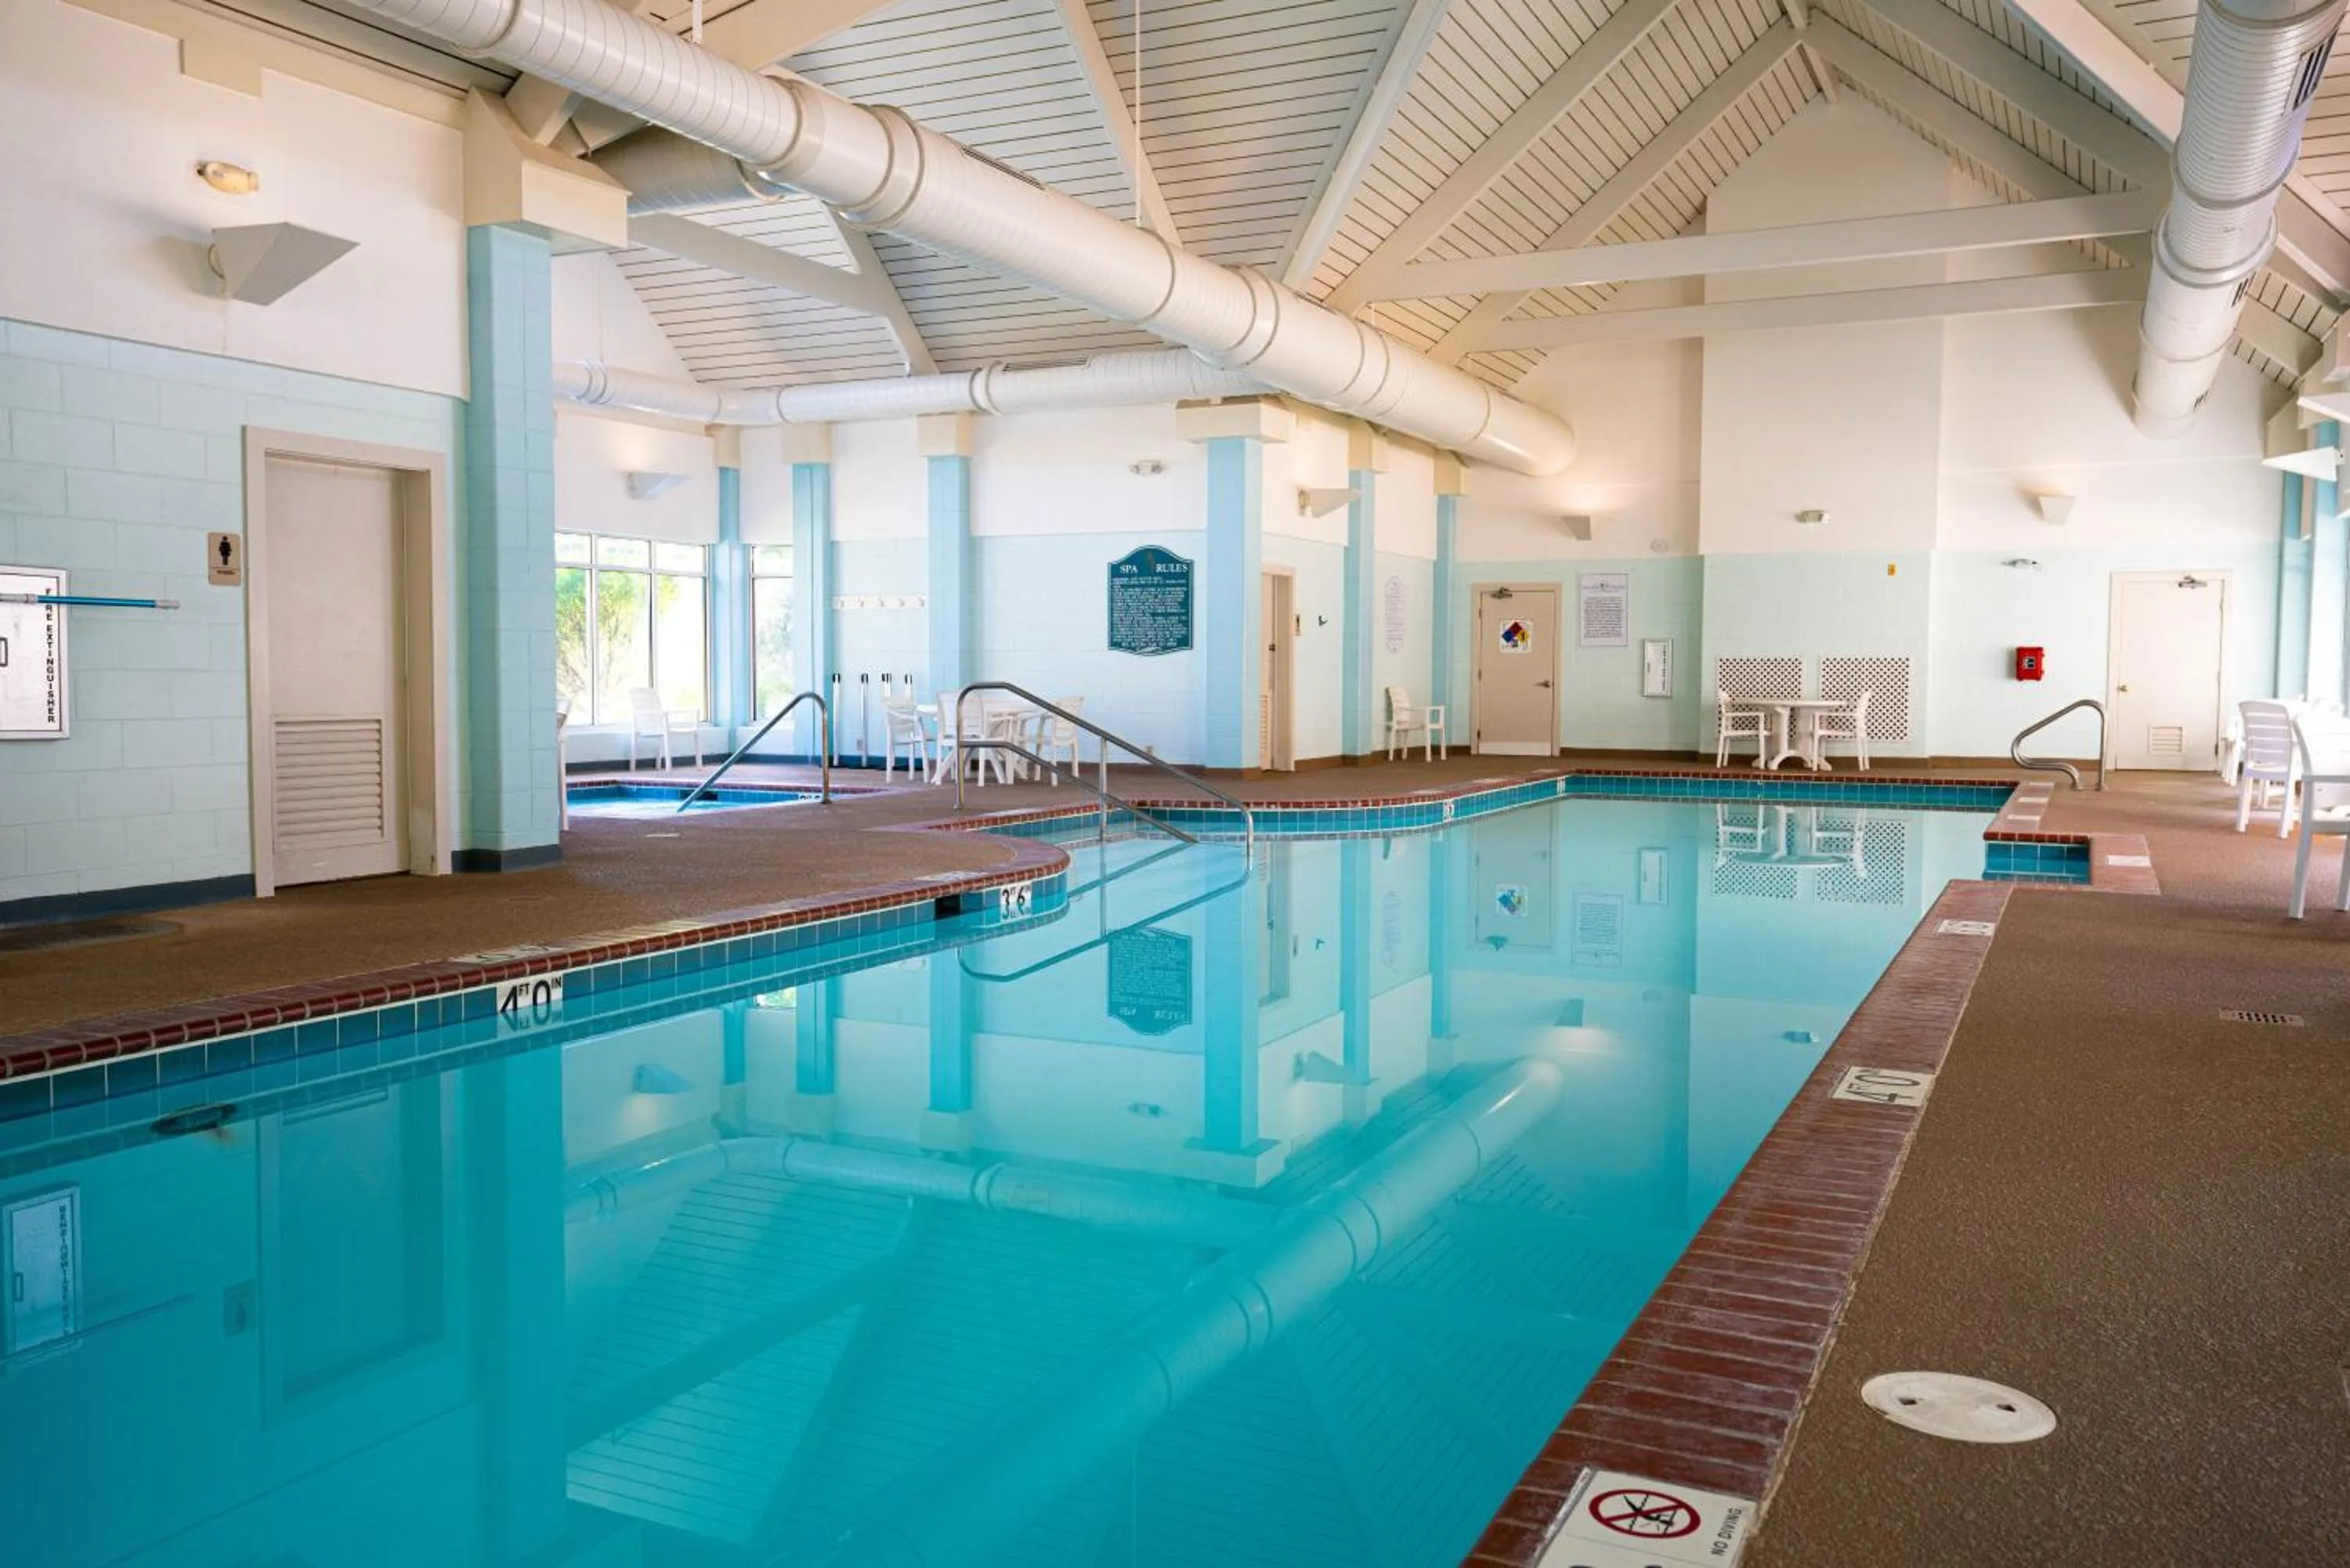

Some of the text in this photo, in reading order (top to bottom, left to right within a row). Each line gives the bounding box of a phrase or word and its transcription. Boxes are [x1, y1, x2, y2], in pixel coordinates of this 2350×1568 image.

[1119, 563, 1188, 573] SPA RULES
[46, 624, 56, 723] EXTINGUISHER
[519, 983, 530, 996] FT
[1710, 1507, 1742, 1556] NO DIVING
